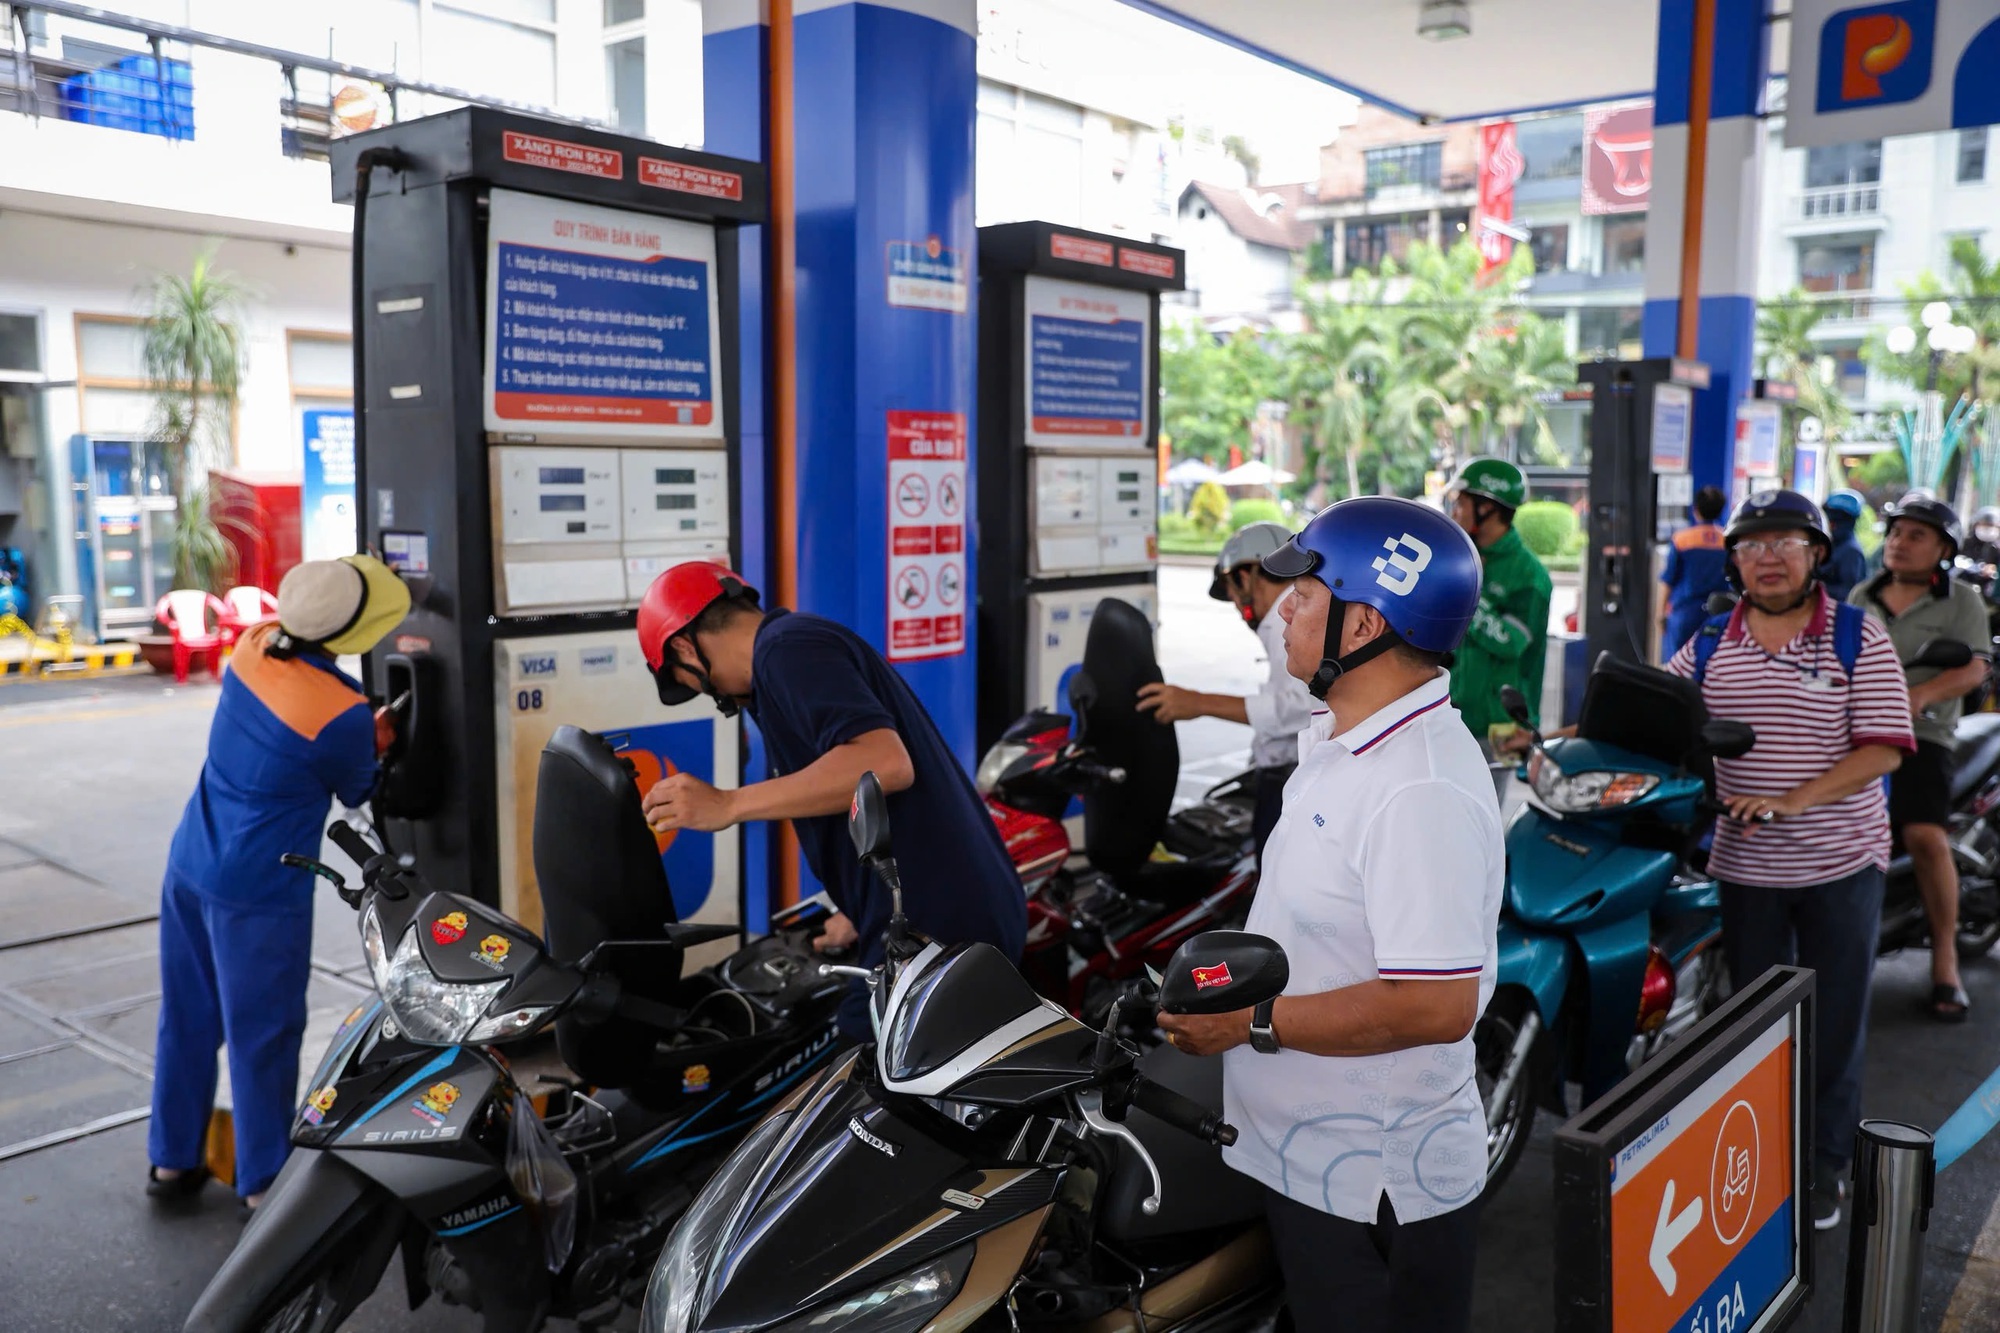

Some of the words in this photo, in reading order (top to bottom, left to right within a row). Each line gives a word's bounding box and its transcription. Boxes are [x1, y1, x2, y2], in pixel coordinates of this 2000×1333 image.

[554, 145, 584, 161] RON
[585, 151, 613, 166] 95-V
[553, 219, 574, 238] QUY
[521, 658, 556, 673] VISA
[518, 690, 542, 711] 08
[754, 1024, 840, 1092] SIRIUS
[363, 1126, 457, 1142] SIRIUS
[849, 1117, 895, 1157] HONDA
[1621, 1115, 1670, 1166] PETROLIMEX
[441, 1194, 511, 1227] YAMAHA
